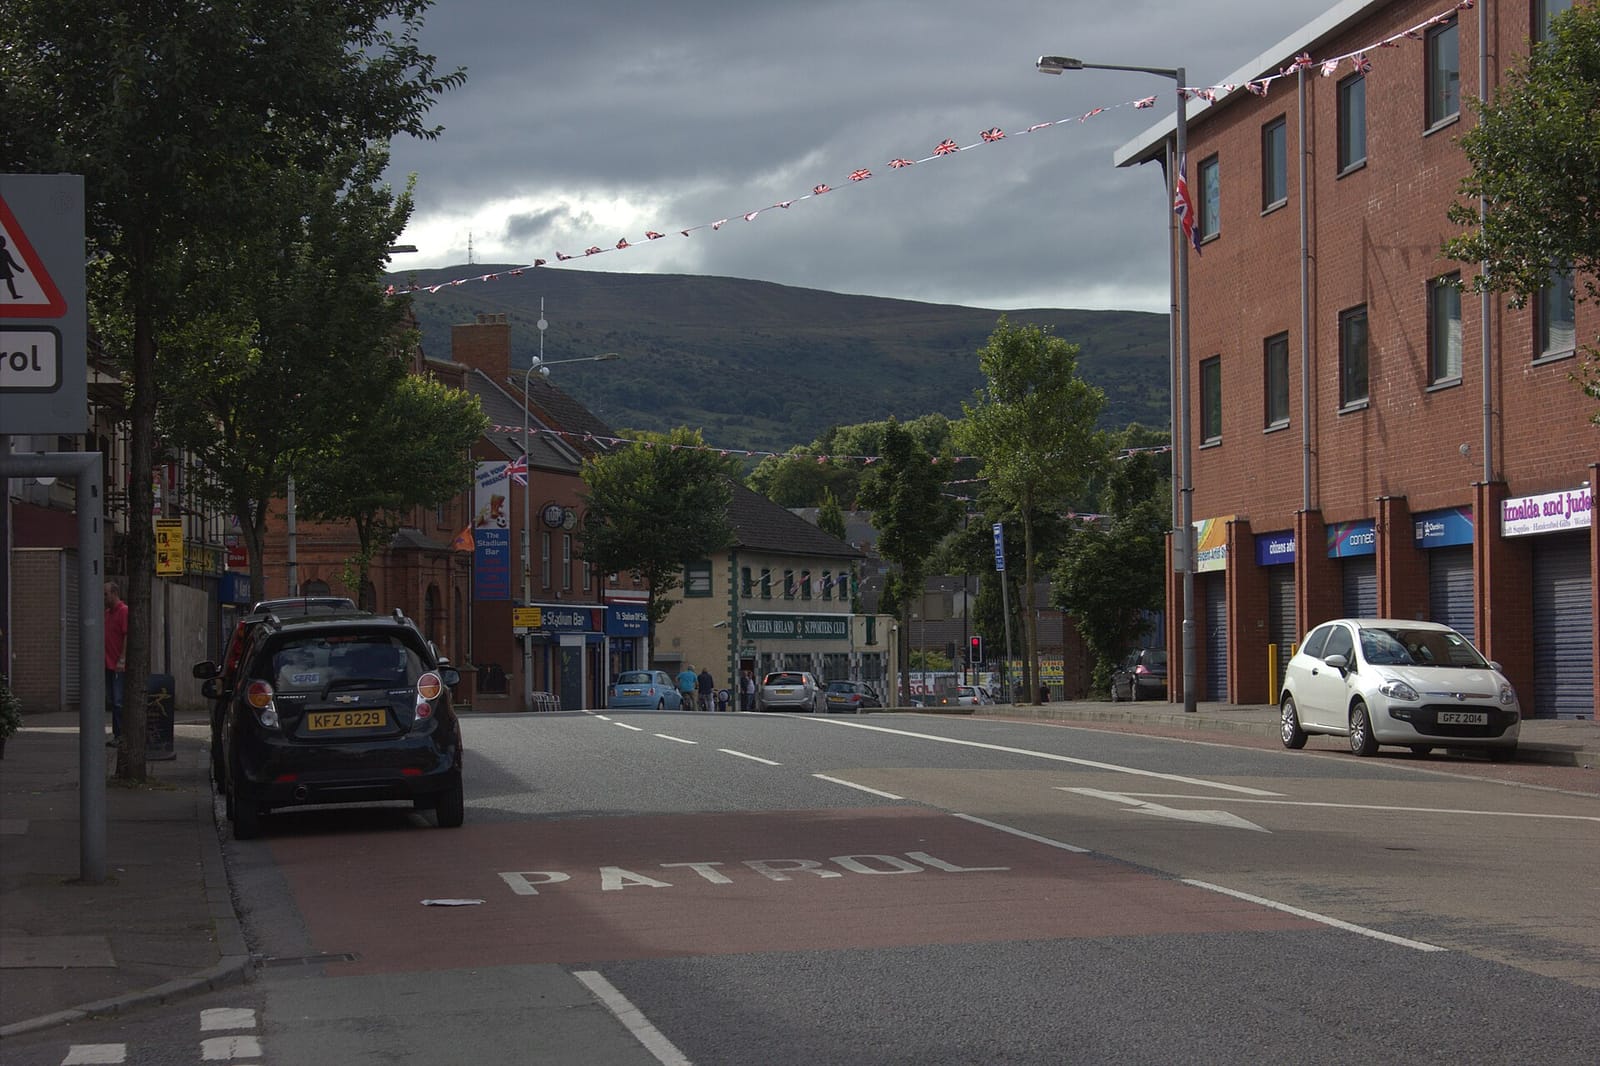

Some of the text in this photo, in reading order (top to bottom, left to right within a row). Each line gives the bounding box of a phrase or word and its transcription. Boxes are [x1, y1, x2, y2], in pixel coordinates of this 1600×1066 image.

[1504, 499, 1540, 522] imelda
[1543, 493, 1563, 516] and
[477, 539, 508, 547] Stadium
[485, 548, 500, 556] Bar
[573, 612, 585, 626] Bar
[746, 619, 846, 634] NORTHERN IRELAND SUPPORTERS CLUB
[314, 711, 380, 729] KFZ 8229
[1443, 713, 1482, 723] GFZ 2014
[497, 851, 1011, 896] PATROL
